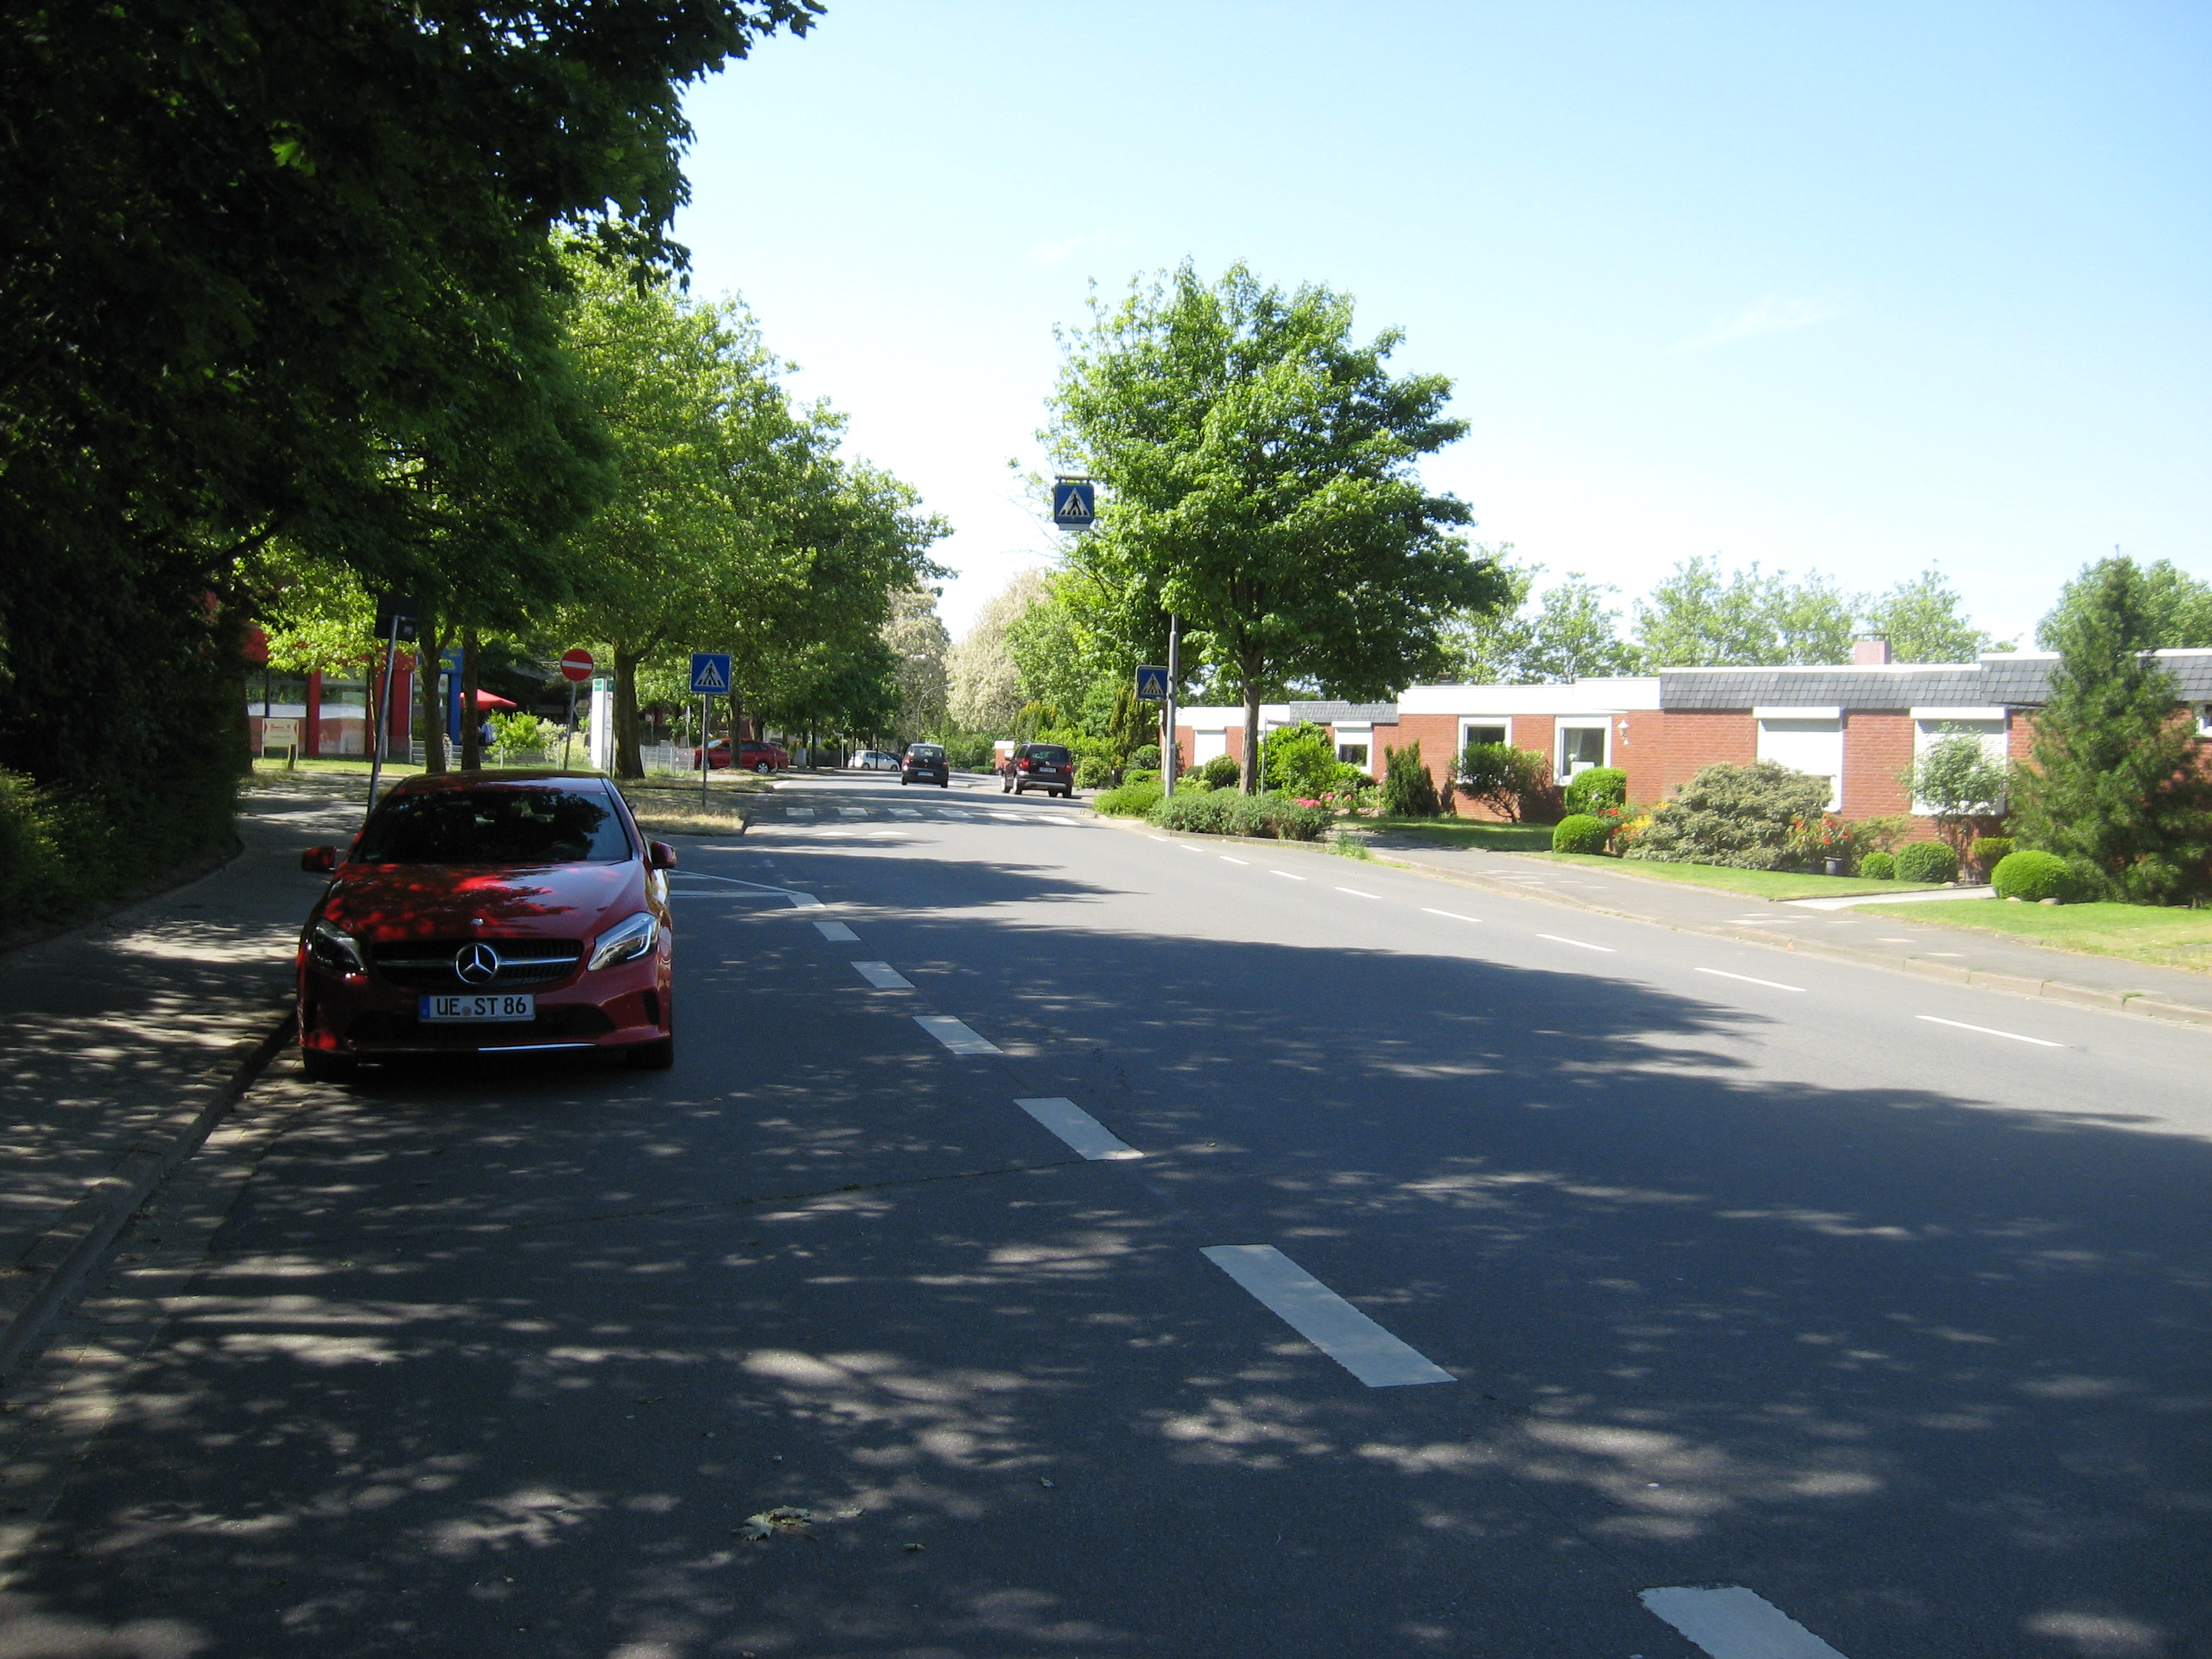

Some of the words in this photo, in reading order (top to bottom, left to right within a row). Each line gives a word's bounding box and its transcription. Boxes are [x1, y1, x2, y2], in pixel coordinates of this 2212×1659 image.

[436, 998, 461, 1016] UE
[475, 997, 498, 1015] ST
[504, 997, 526, 1015] 86
